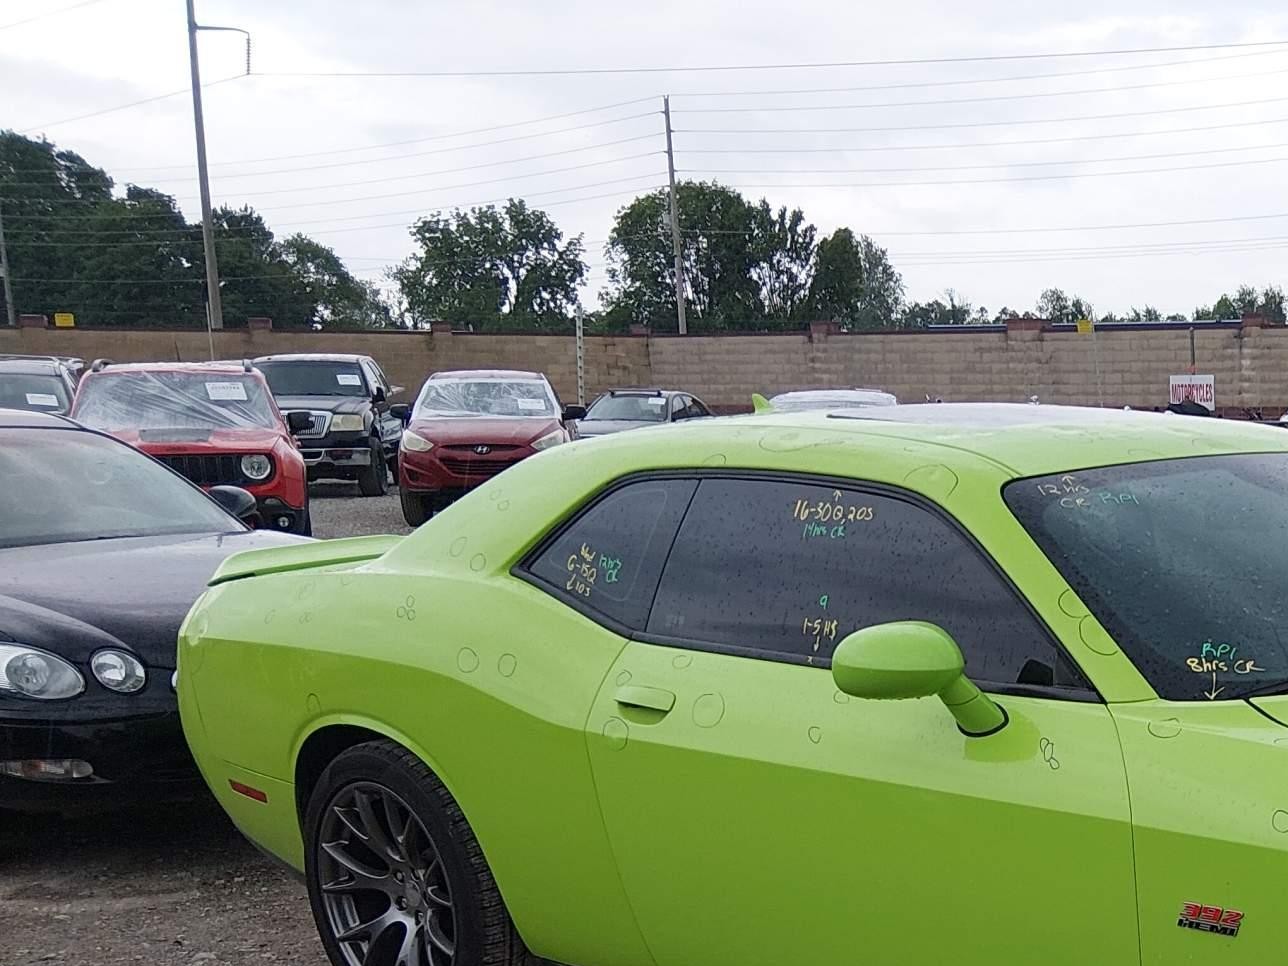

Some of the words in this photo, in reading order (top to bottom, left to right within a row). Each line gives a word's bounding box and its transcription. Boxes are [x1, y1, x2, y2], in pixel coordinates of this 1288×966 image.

[1171, 384, 1213, 403] MOTORCYCLES
[1180, 900, 1245, 927] 392
[1176, 917, 1240, 938] HEMI
